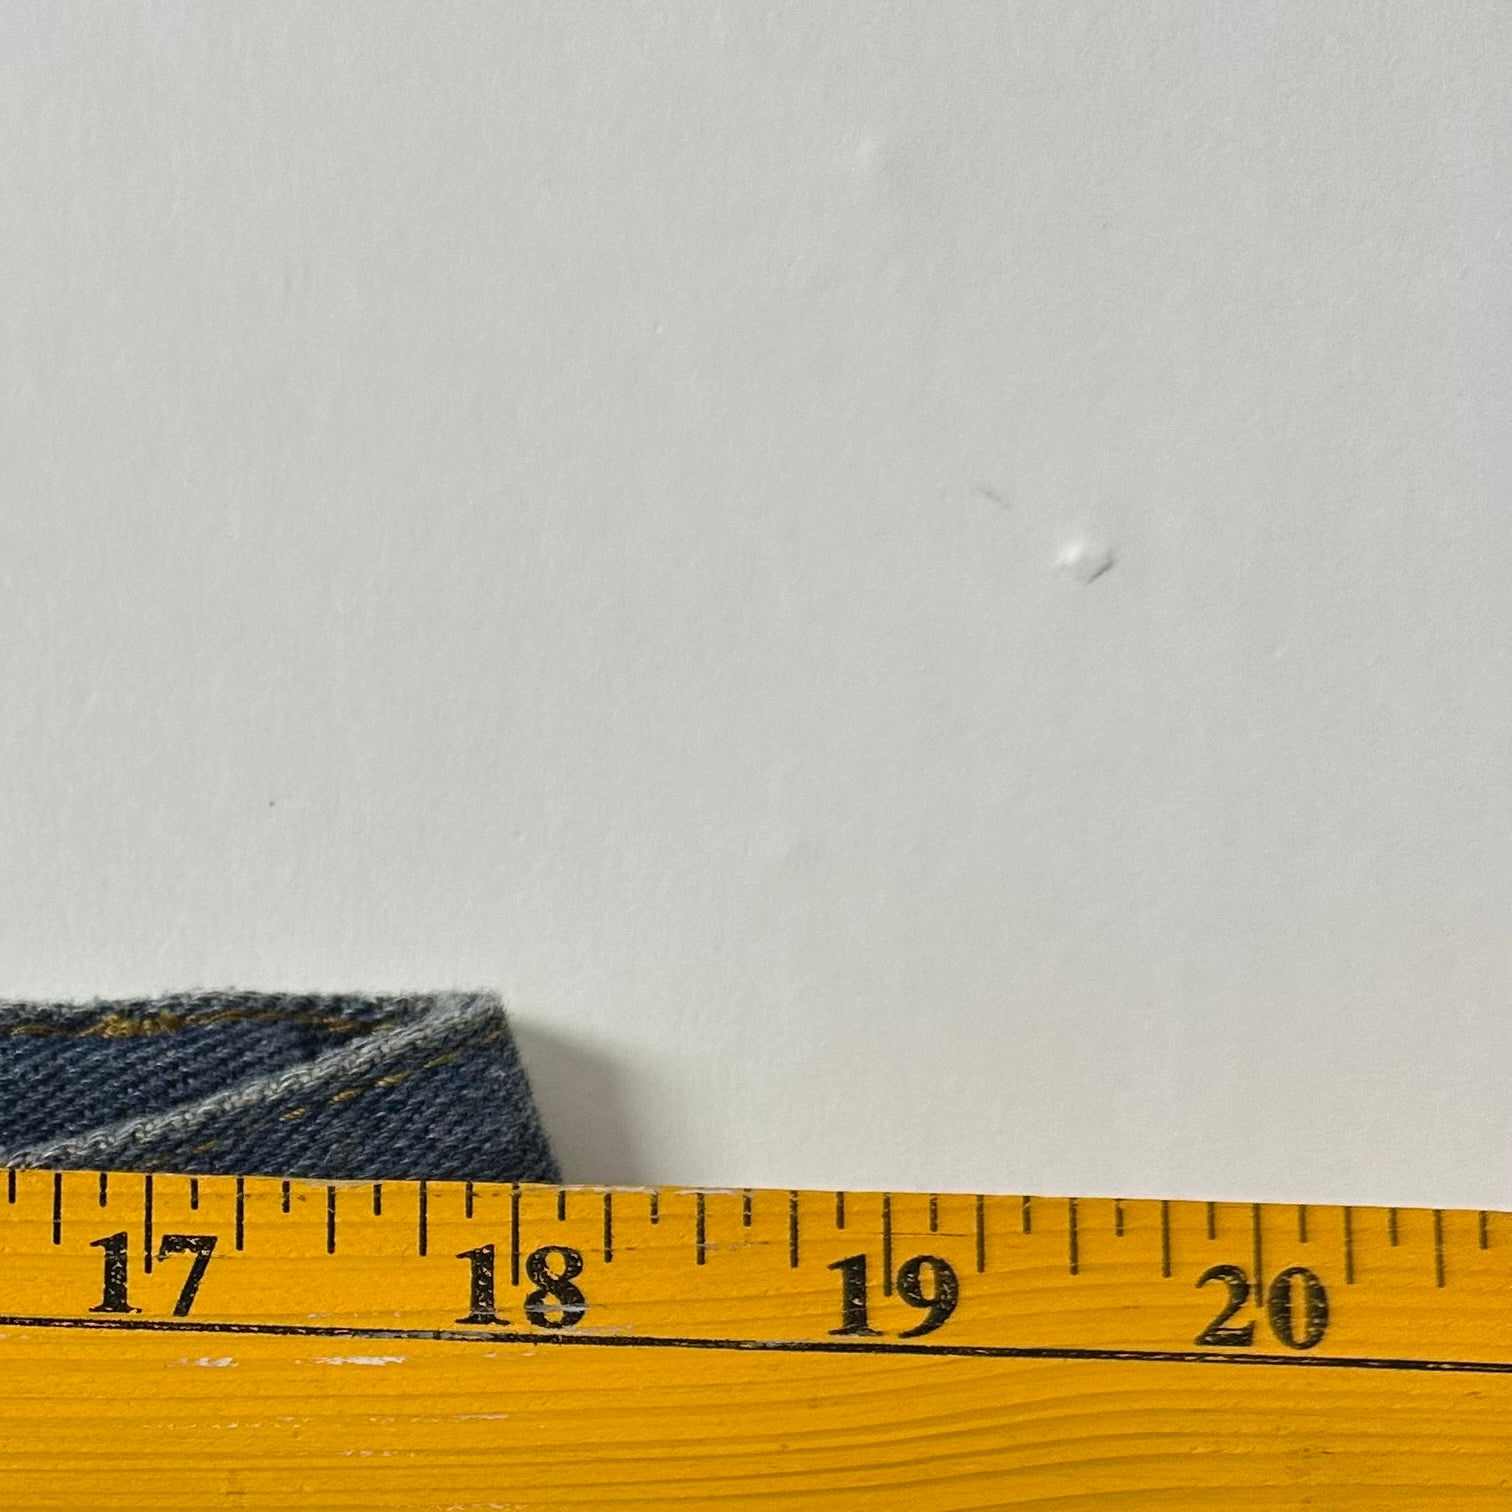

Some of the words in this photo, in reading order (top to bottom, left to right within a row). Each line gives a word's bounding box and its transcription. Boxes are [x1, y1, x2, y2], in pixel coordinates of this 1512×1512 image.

[88, 1232, 217, 1317] 17
[455, 1244, 586, 1329] 18
[828, 1254, 960, 1339] 19
[1194, 1264, 1330, 1350] 20
